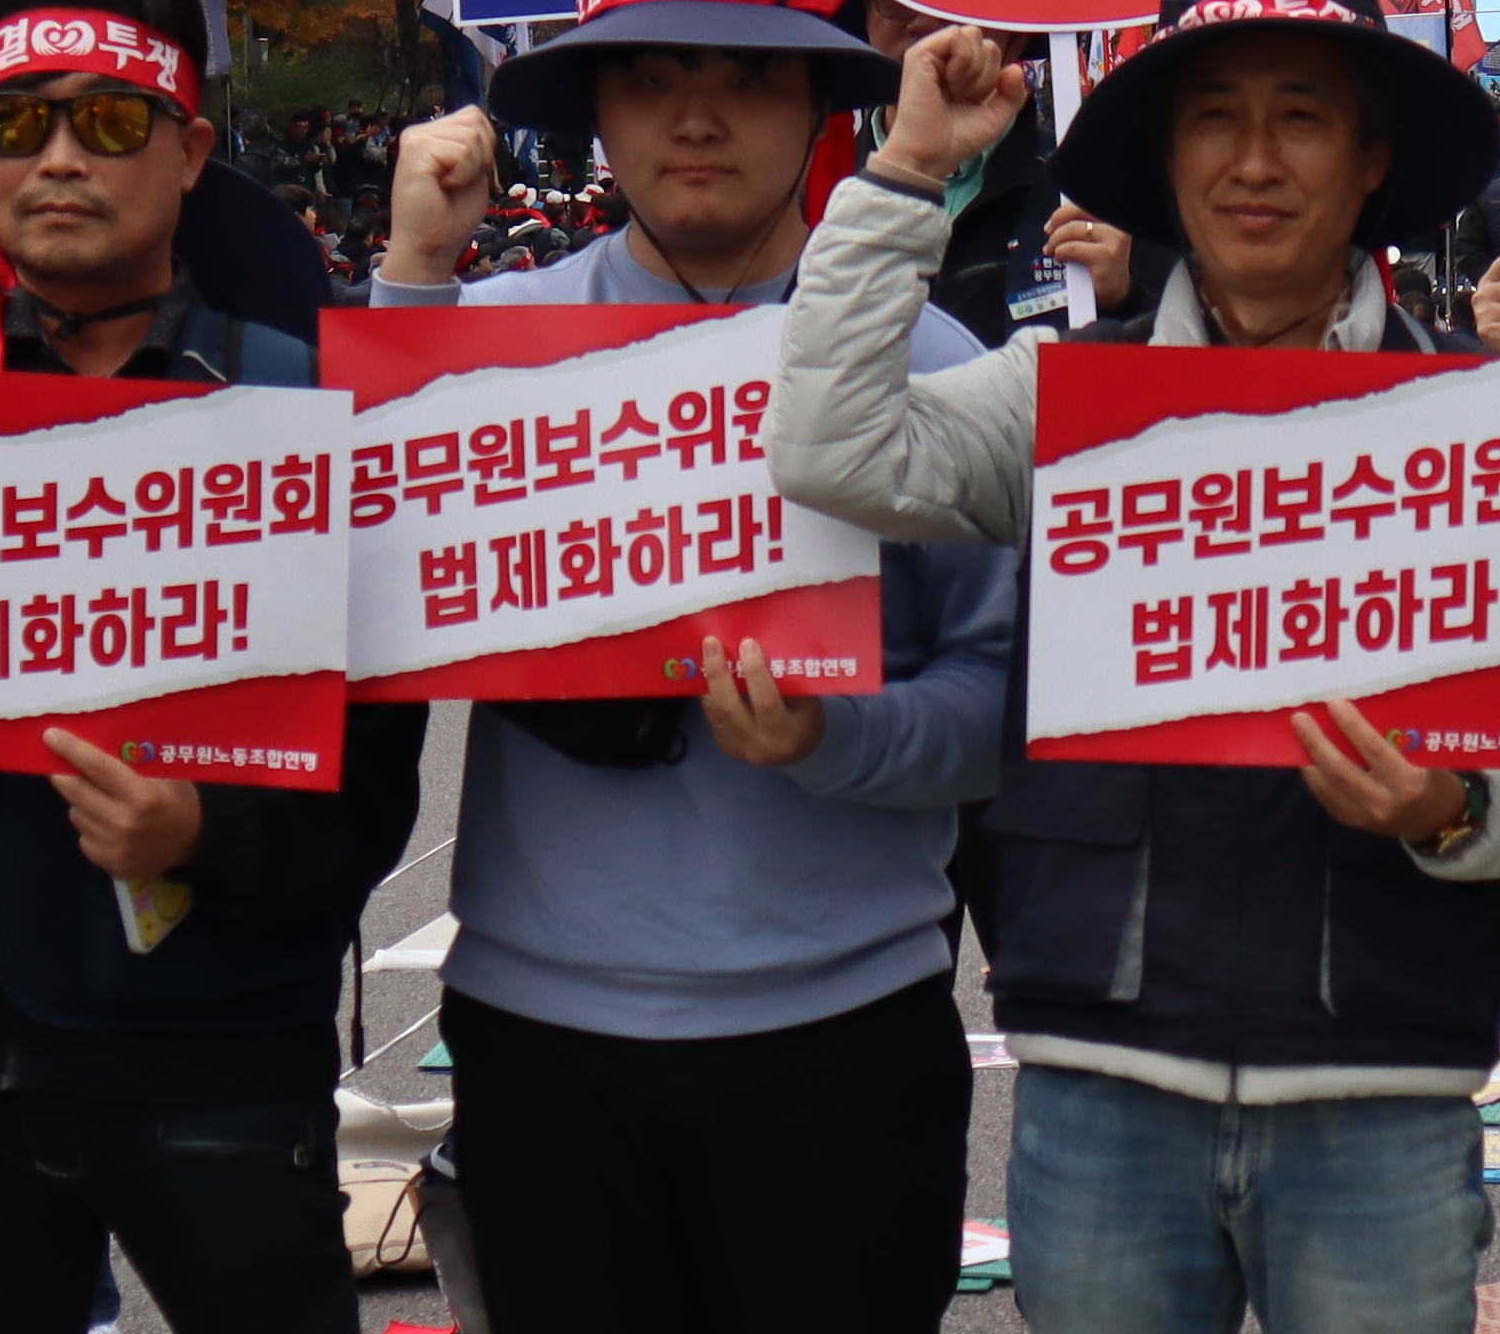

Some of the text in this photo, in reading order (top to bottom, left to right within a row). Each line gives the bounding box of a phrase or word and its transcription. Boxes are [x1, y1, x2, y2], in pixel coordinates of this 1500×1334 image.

[99, 20, 180, 92] 투쟁
[350, 379, 772, 529] 공무원보수위원
[420, 494, 785, 630] 법제화하라!
[160, 745, 318, 772] 공무원노동조합연맹
